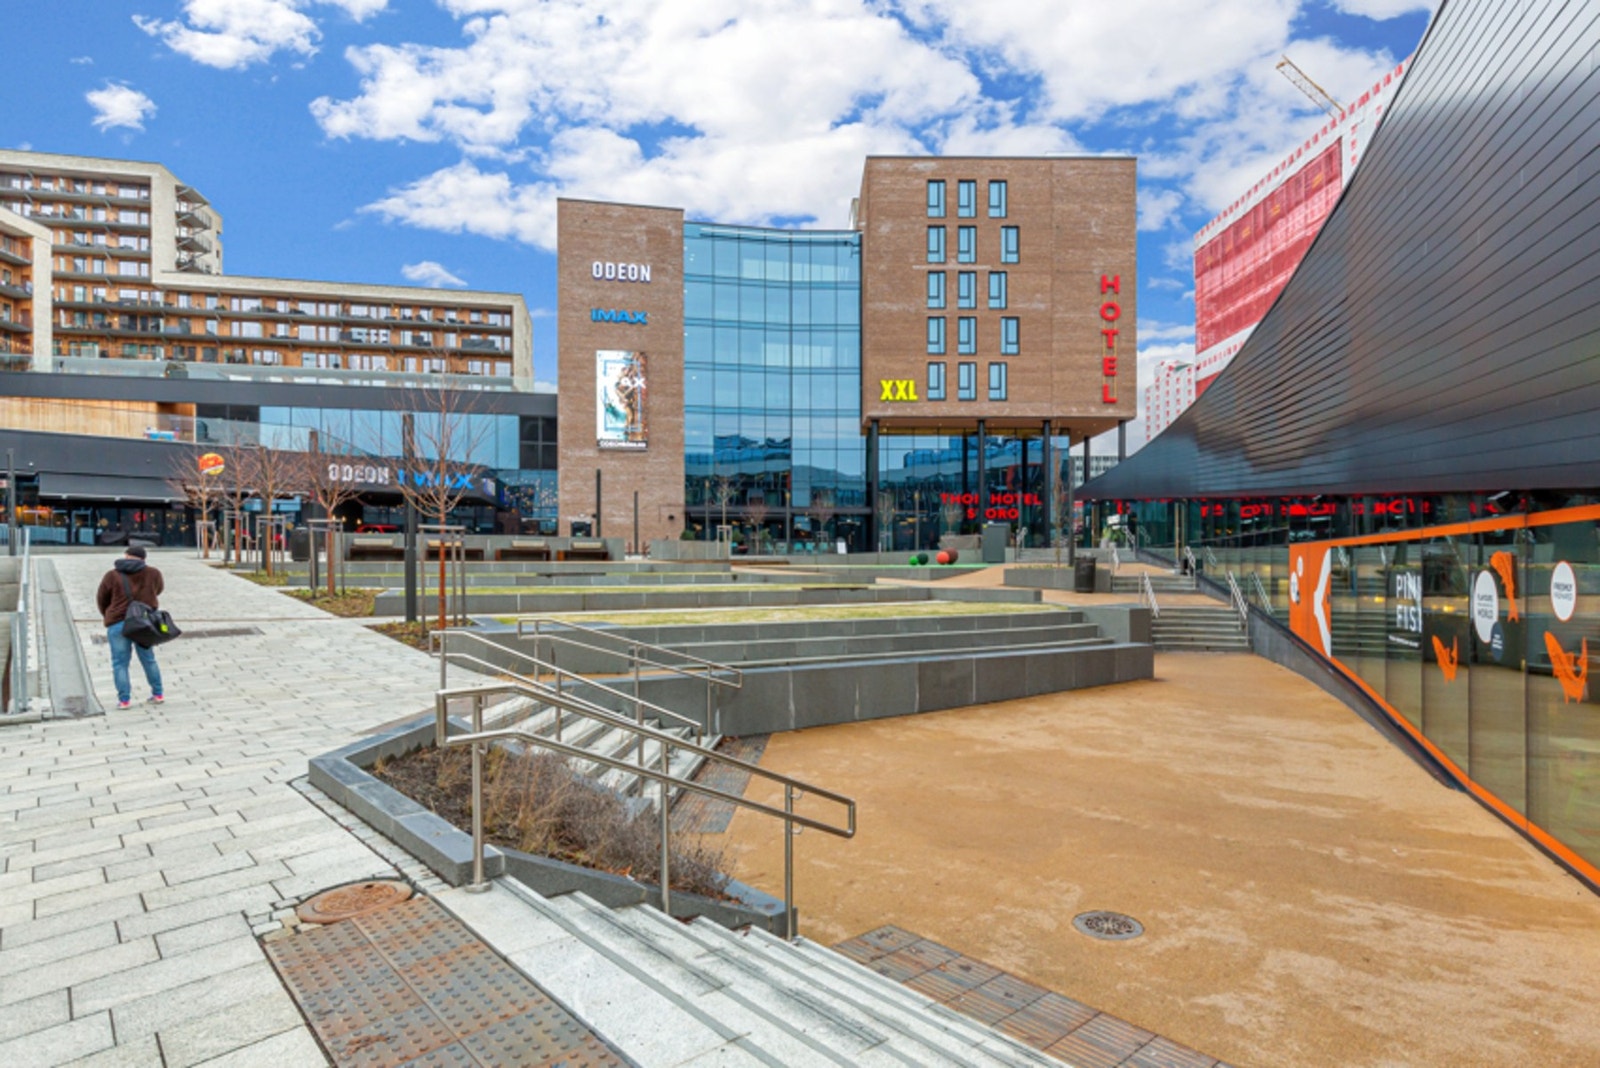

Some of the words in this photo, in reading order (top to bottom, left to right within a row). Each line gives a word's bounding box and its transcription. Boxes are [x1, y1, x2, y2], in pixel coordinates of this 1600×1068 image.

[592, 261, 651, 282] ODEON
[591, 308, 648, 325] IMAX
[1100, 274, 1120, 404] HOTEL
[880, 379, 918, 401] XXL
[328, 464, 389, 485] ODEON
[990, 493, 1042, 505] HOTEL
[967, 507, 1019, 519] SORO
